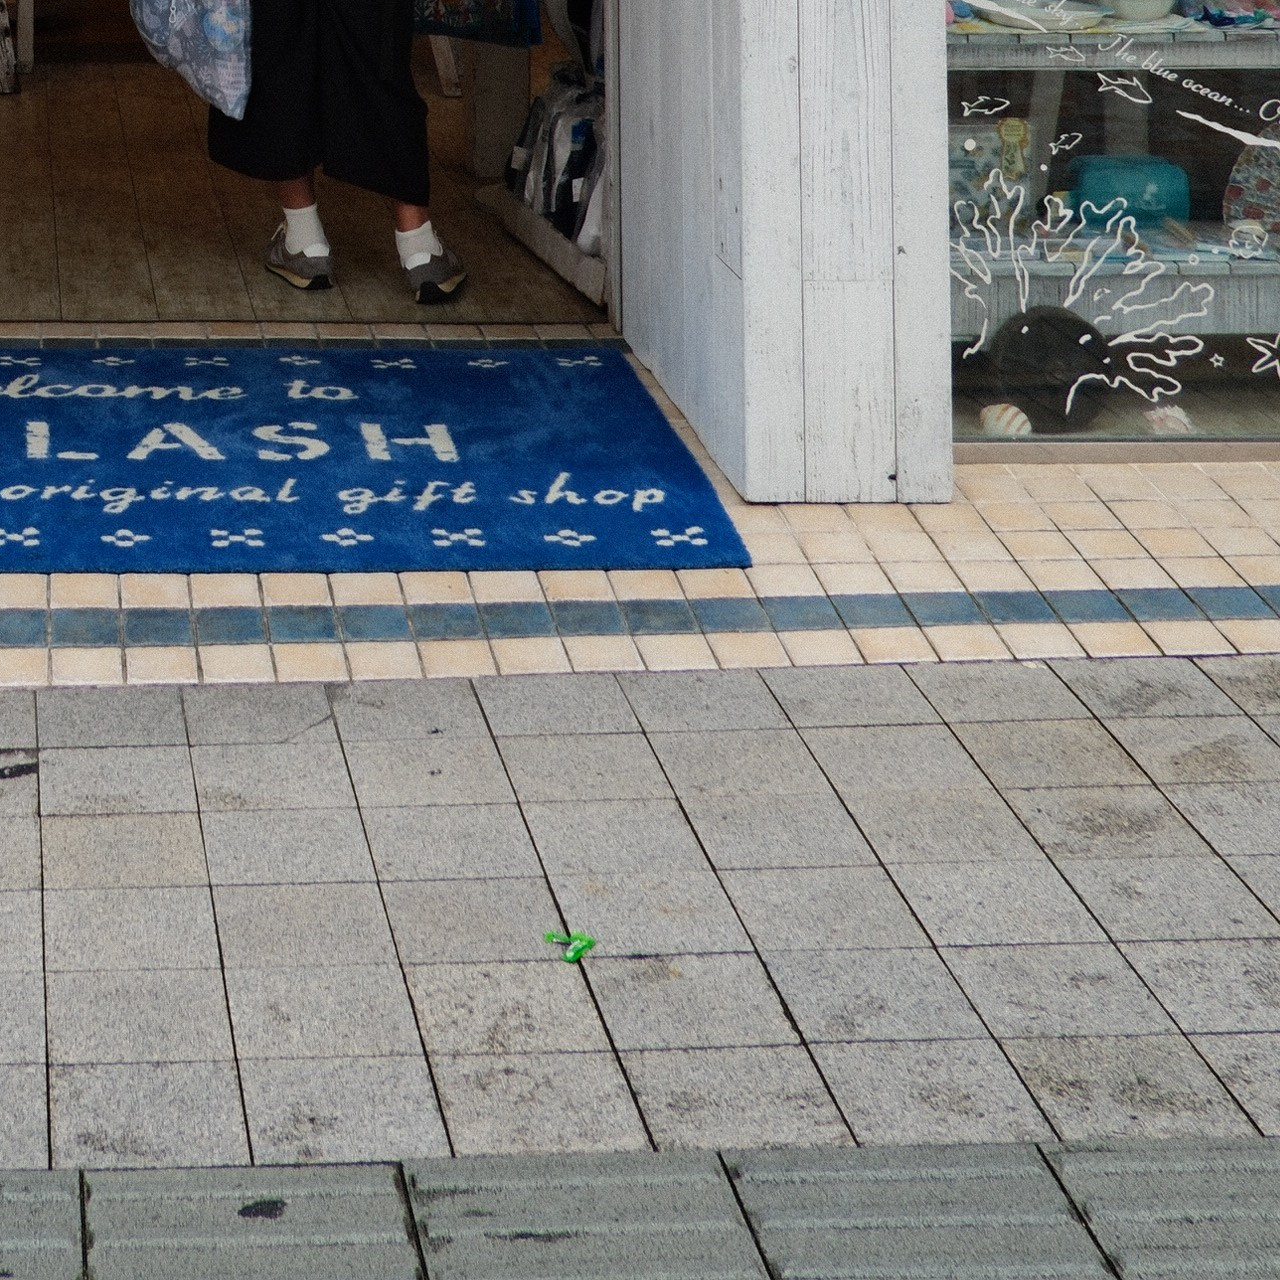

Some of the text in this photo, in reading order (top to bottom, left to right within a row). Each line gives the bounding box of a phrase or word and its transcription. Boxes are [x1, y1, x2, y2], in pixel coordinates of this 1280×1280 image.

[1098, 33, 1137, 63] The
[1141, 51, 1178, 82] blue
[284, 379, 359, 401] to
[0, 476, 301, 514] original
[337, 479, 479, 515] gift
[509, 471, 666, 512] shop
